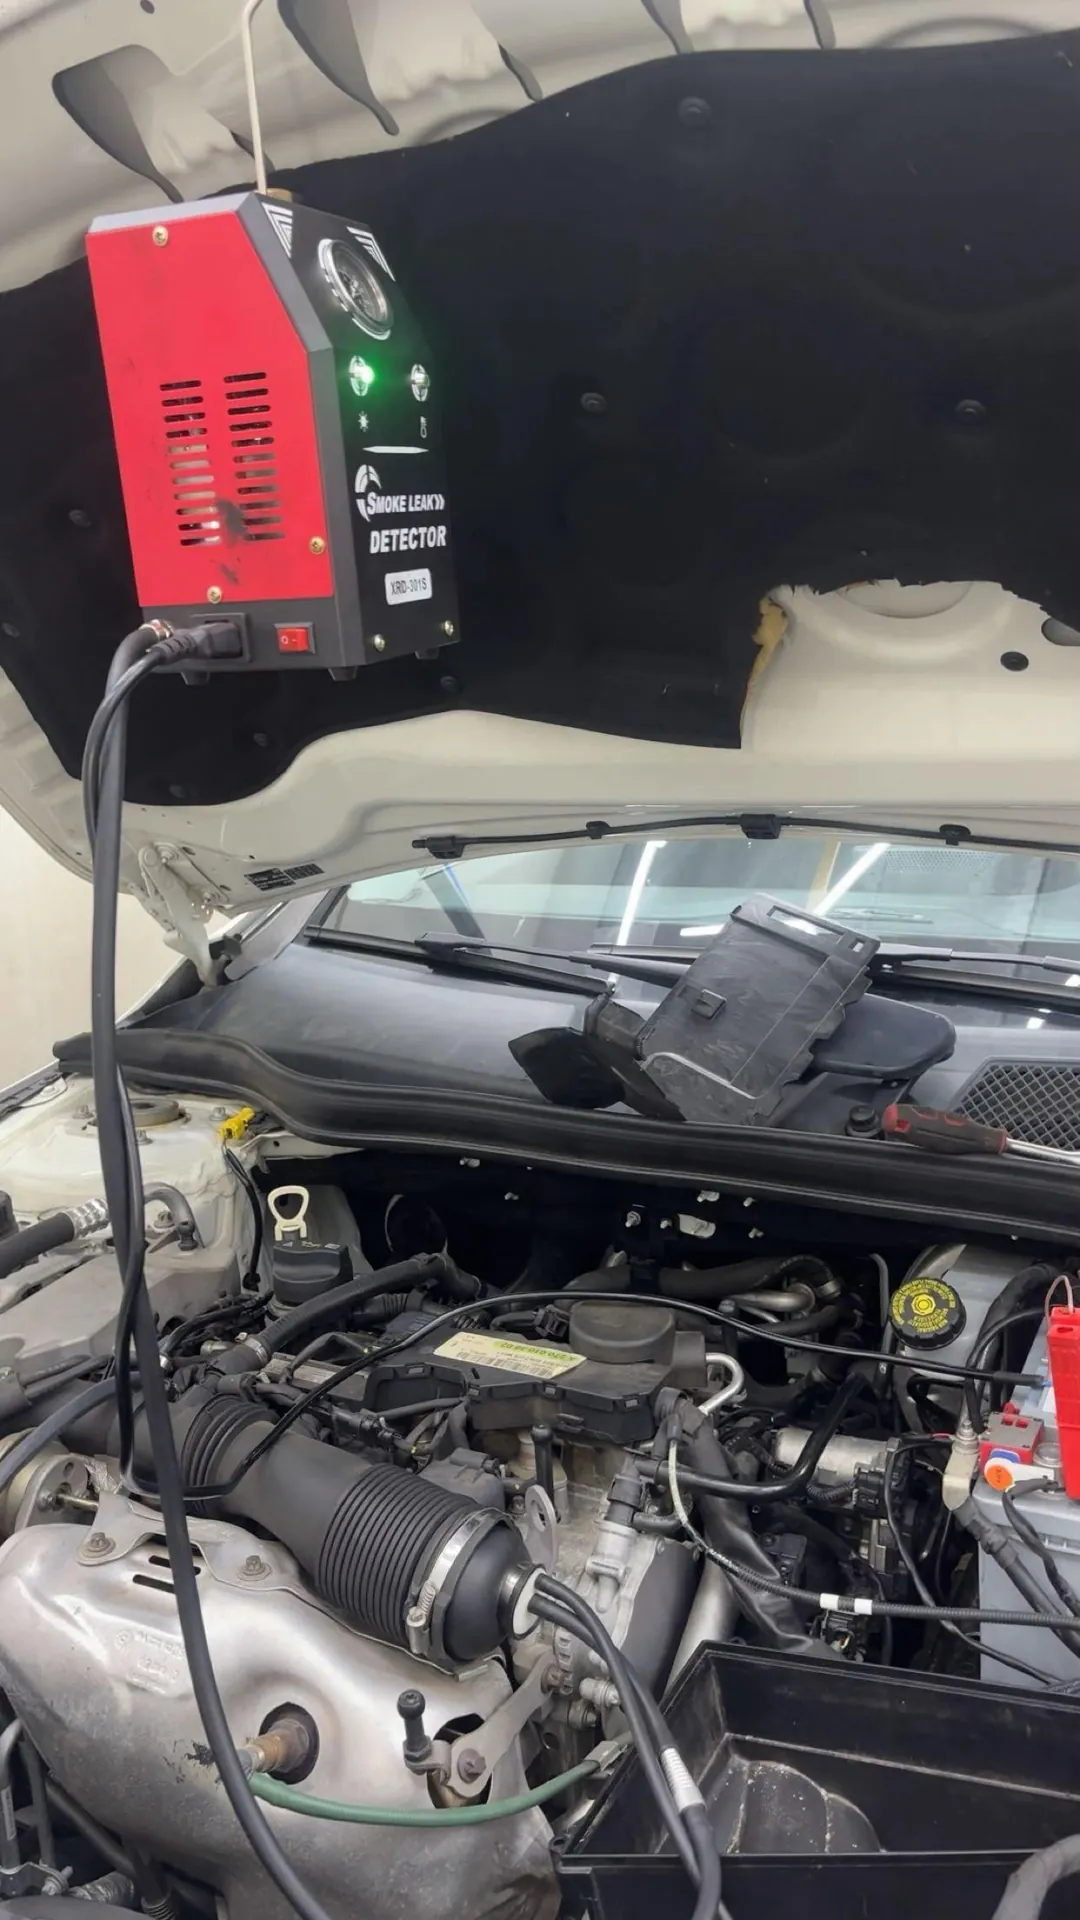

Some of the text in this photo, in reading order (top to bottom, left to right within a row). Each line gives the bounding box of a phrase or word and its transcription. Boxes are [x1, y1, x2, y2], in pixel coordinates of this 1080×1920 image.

[367, 492, 435, 515] SMOKE LEAK
[370, 525, 447, 554] DETECTOR
[390, 577, 428, 596] XRD-301S
